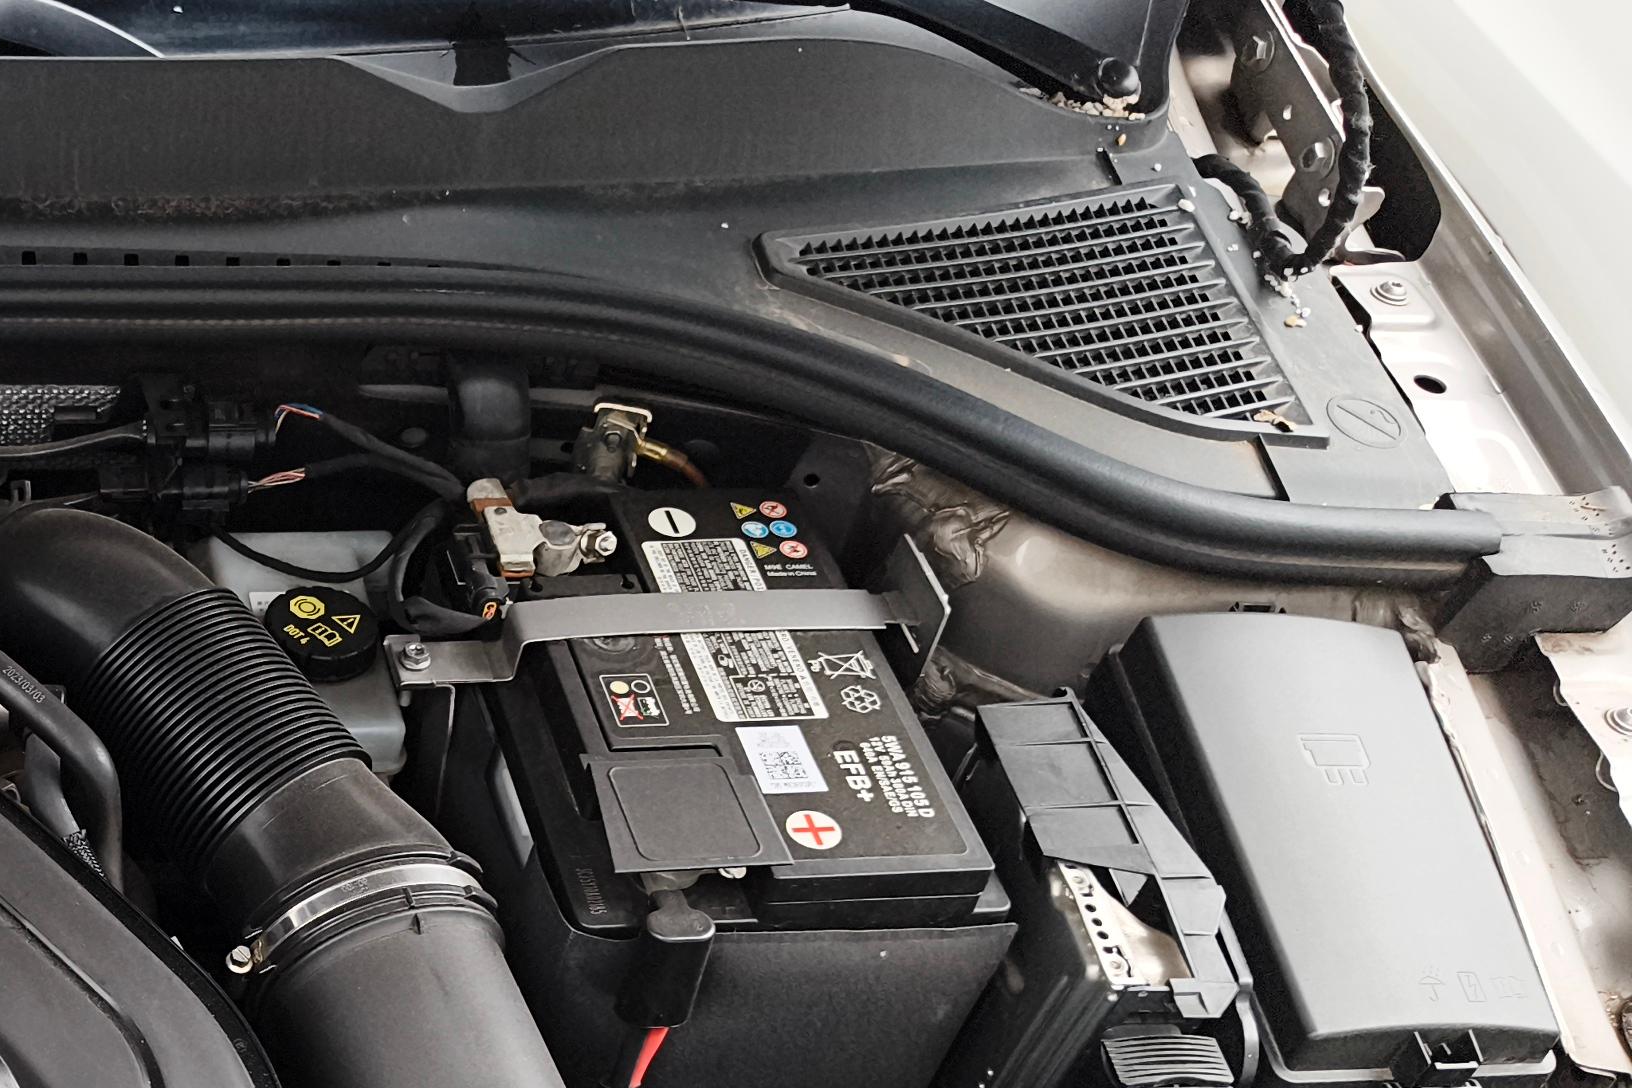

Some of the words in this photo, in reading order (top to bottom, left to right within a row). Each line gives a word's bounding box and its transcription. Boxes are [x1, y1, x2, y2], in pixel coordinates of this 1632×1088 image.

[283, 624, 304, 640] DOT
[300, 637, 311, 645] 4
[2, 665, 46, 704] 2023/03/03
[881, 735, 906, 761] 5WA
[832, 750, 874, 802] EFB+
[894, 762, 919, 783] 915
[906, 785, 930, 806] 105
[901, 800, 919, 817] DIN
[917, 808, 935, 818] D
